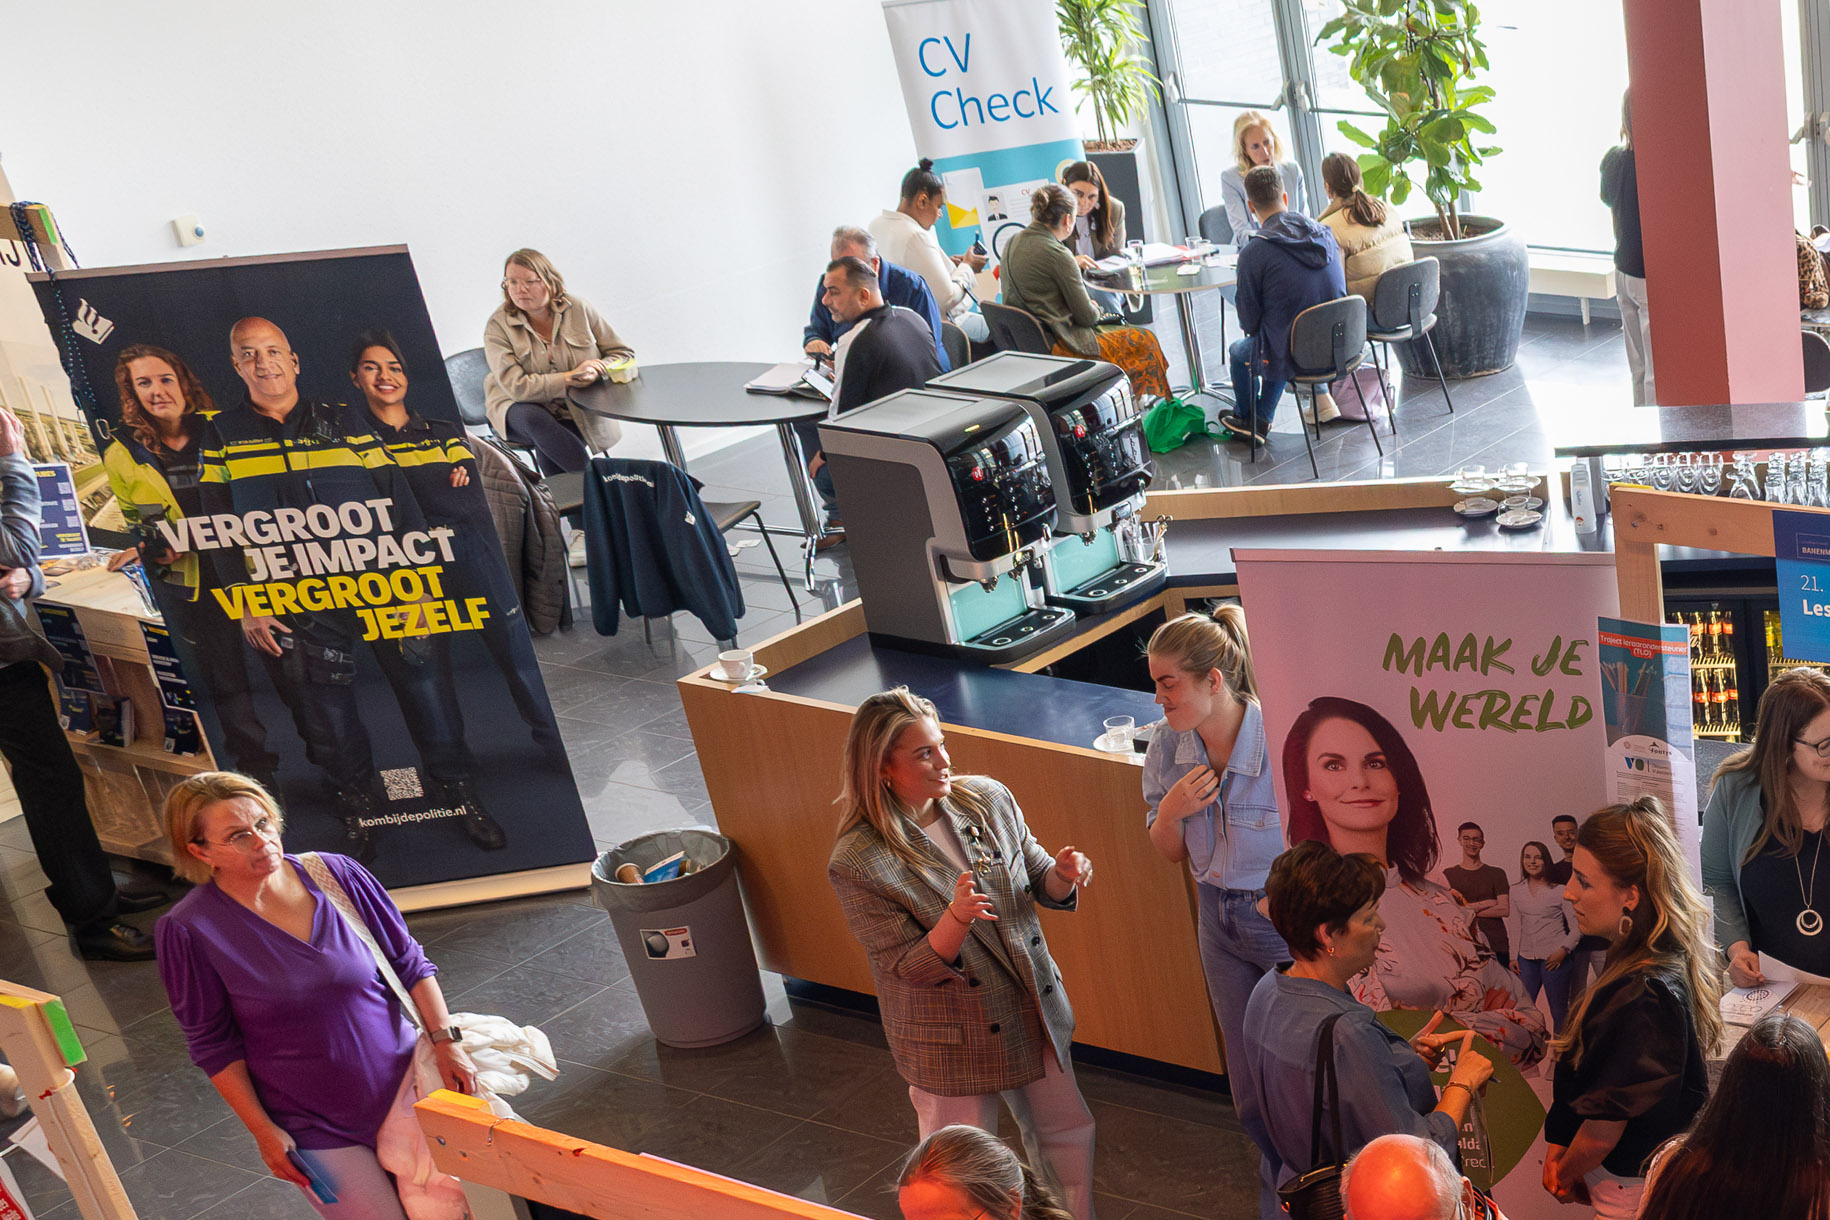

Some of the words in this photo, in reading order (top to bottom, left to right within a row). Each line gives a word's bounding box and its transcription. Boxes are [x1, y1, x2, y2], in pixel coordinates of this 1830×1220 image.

[919, 33, 970, 77] CV
[931, 77, 1060, 129] Check
[156, 498, 393, 553] VERGROOT
[244, 544, 295, 582] JE
[292, 529, 455, 576] IMPACT
[210, 566, 443, 620] VERGROOT
[1800, 575, 1824, 592] 21.
[356, 597, 490, 641] JEZELF
[1600, 634, 1622, 646] Traject
[1382, 632, 1515, 677] MAAK
[1531, 635, 1589, 676] JE
[1410, 686, 1593, 732] WERELD
[359, 805, 467, 828] kombijdepolitie.nl
